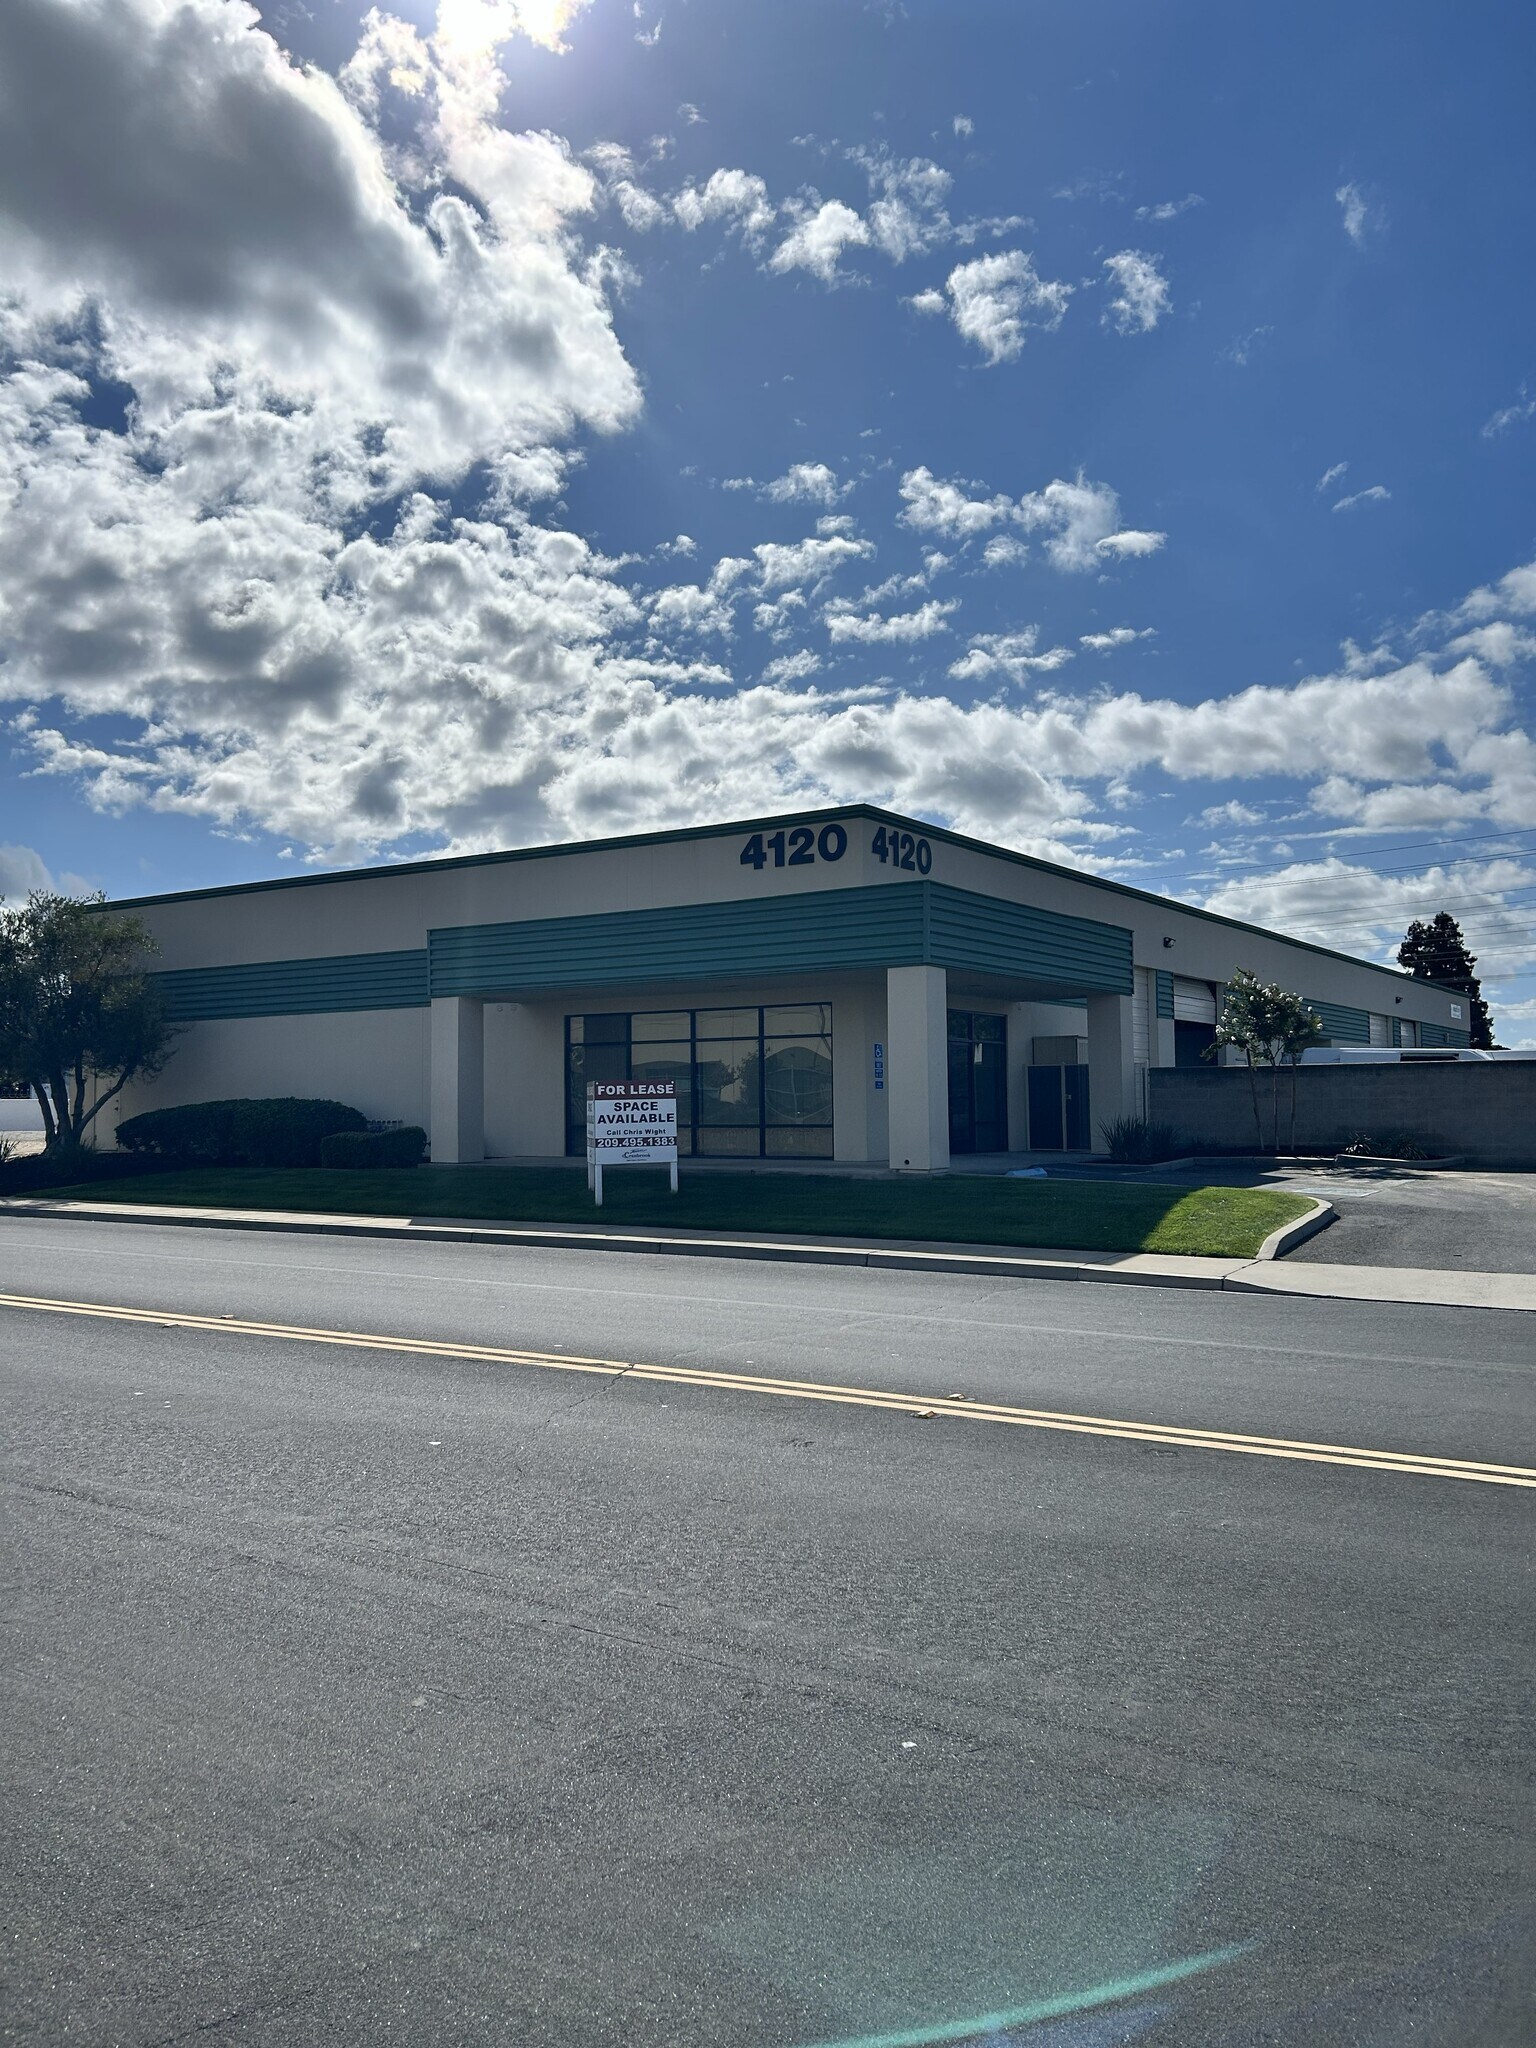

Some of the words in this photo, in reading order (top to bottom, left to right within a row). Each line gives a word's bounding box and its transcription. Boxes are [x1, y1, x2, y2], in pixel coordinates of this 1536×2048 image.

[740, 823, 848, 870] 4120
[871, 826, 932, 875] 4120
[597, 1085, 626, 1095] FOR
[630, 1085, 674, 1095] LEASE
[614, 1102, 658, 1111] SPACE
[597, 1113, 675, 1124] AVAILABLE
[597, 1138, 675, 1147] 209.495.1383
